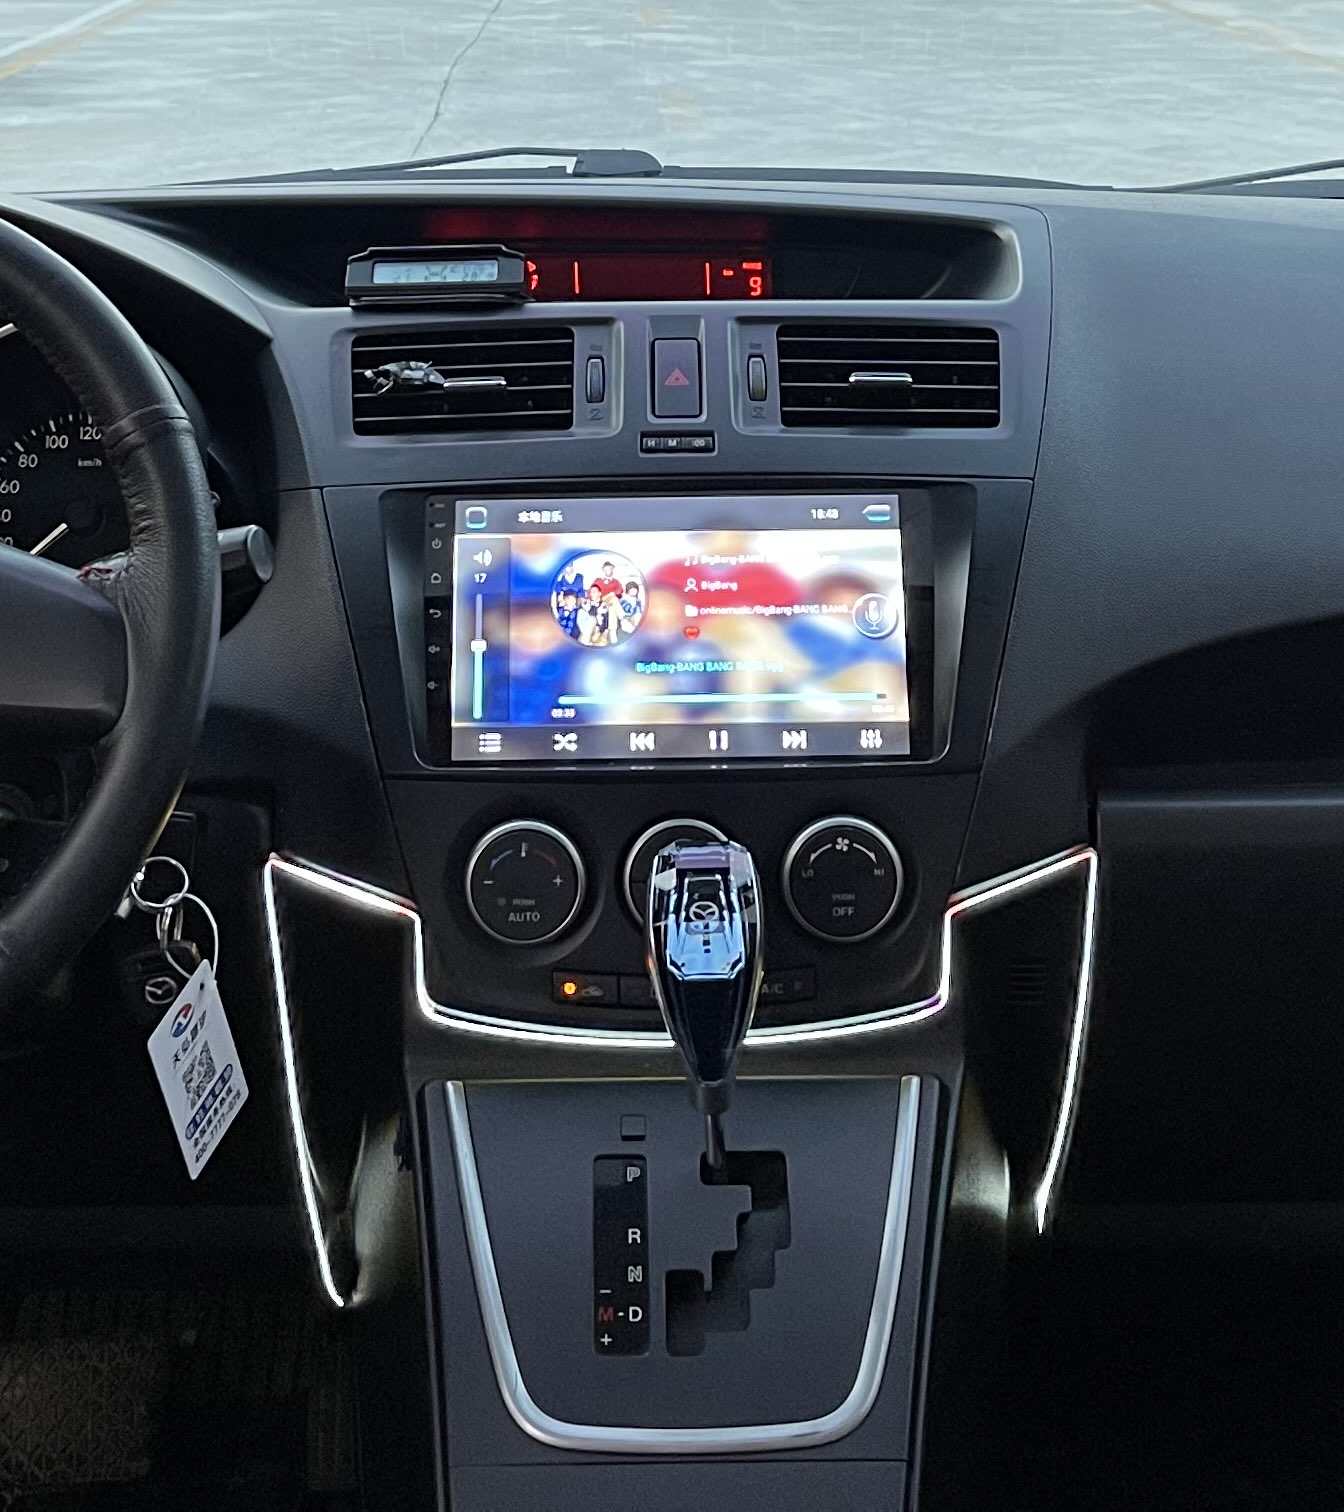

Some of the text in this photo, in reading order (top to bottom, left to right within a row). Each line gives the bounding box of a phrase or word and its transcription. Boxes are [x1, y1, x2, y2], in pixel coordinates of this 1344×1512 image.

[44, 434, 70, 450] 100
[17, 453, 39, 469] 80
[77, 457, 103, 468] km/h
[473, 572, 488, 585] 17
[701, 580, 738, 592] BigBang
[801, 868, 814, 878] LO
[873, 868, 885, 877] HI
[508, 911, 541, 923] AUTO
[832, 906, 855, 917] OFF
[626, 1166, 641, 1183] P
[627, 1227, 642, 1245] R
[627, 1265, 643, 1283] N
[597, 1305, 644, 1323] M D
